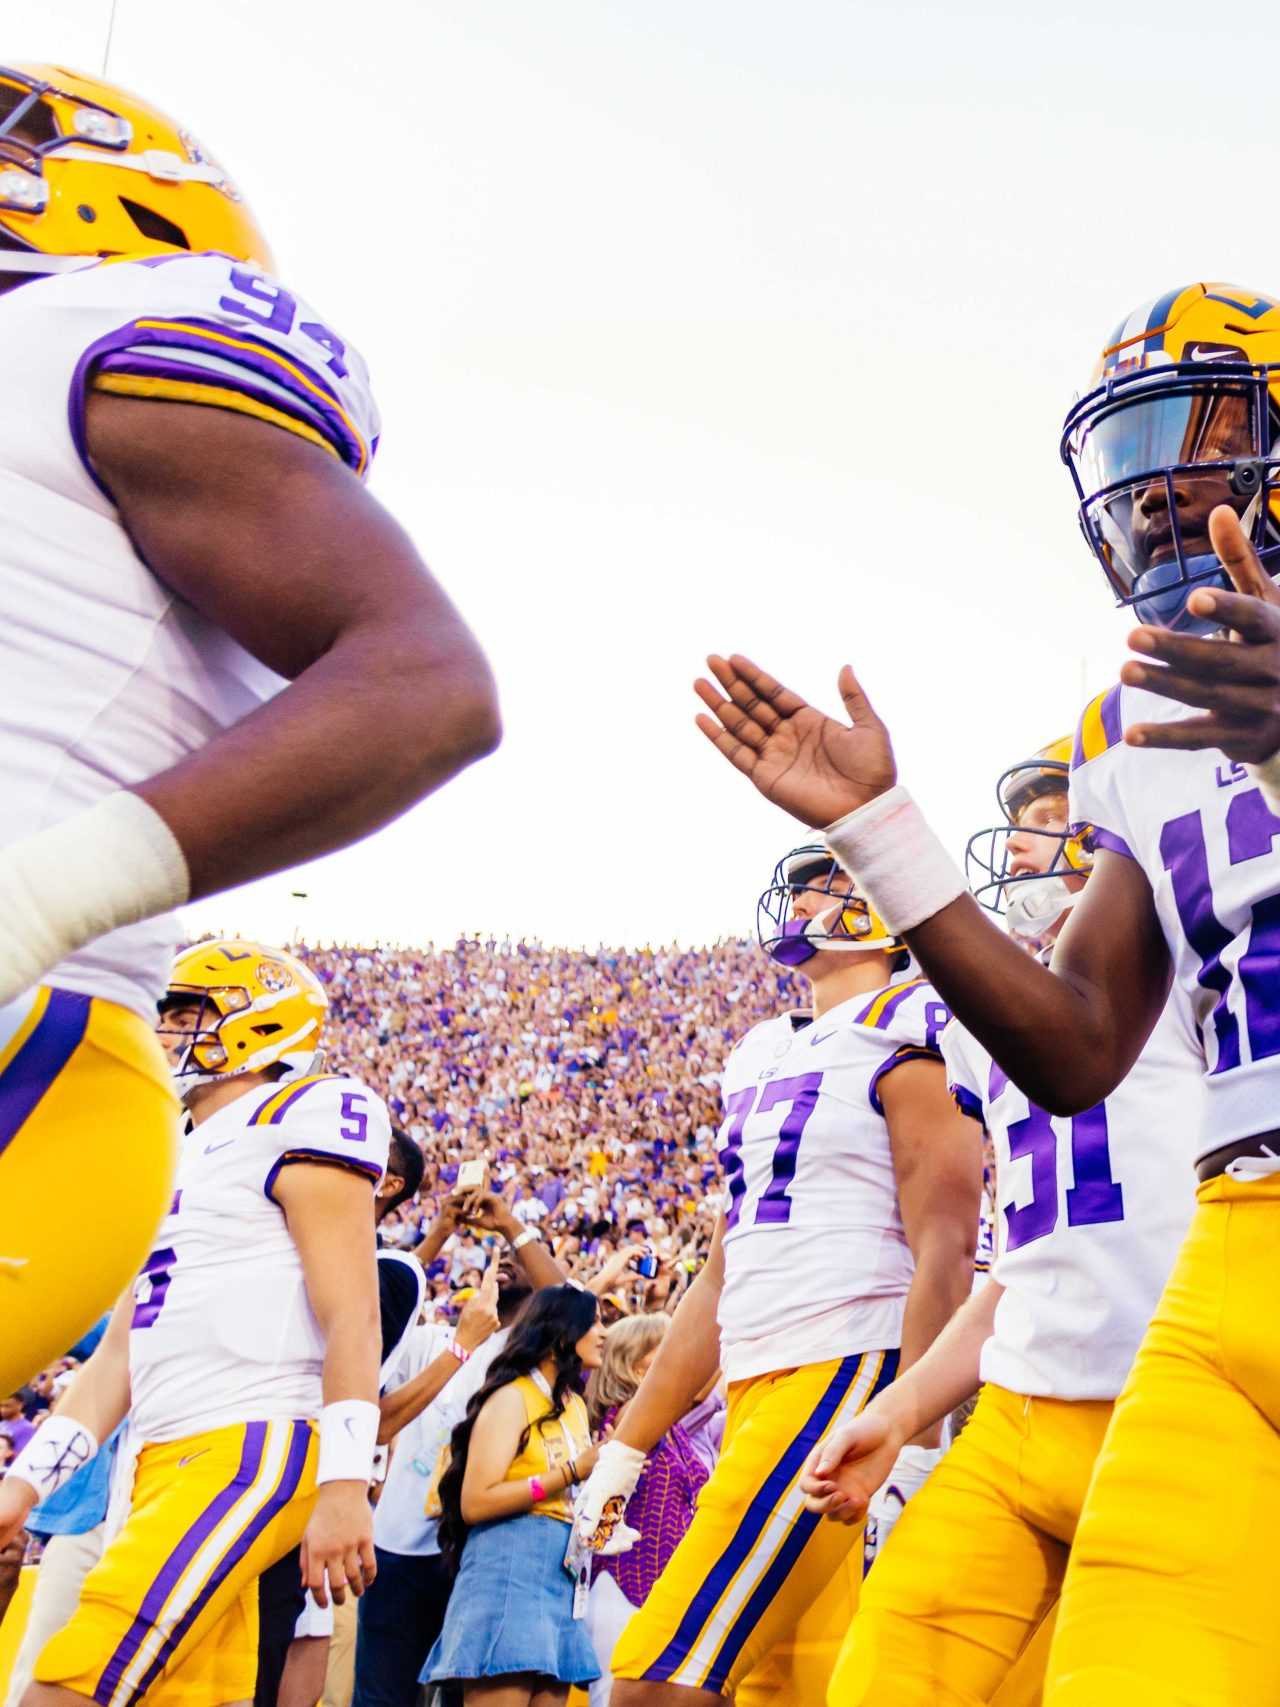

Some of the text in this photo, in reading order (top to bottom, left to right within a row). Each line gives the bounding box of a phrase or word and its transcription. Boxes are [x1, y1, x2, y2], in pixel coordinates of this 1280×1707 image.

[219, 266, 348, 379] 94
[1215, 761, 1248, 788] LS
[339, 1092, 369, 1143] 5
